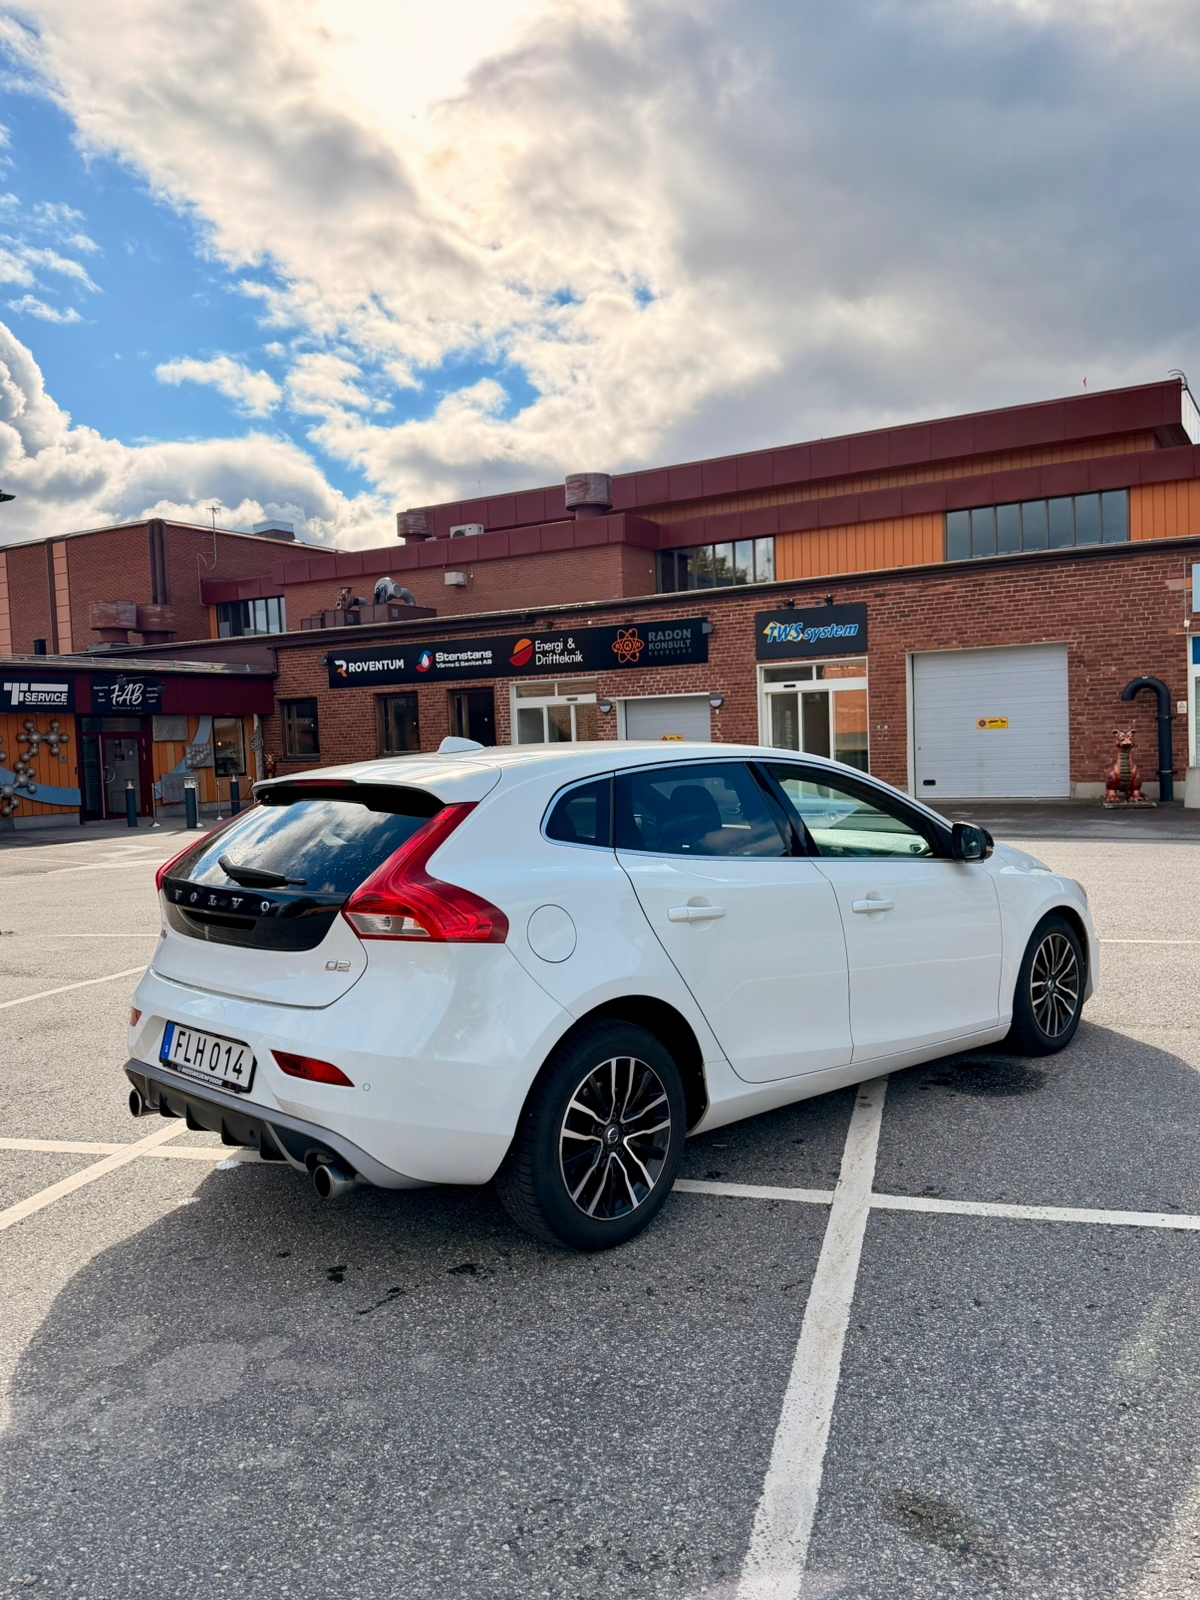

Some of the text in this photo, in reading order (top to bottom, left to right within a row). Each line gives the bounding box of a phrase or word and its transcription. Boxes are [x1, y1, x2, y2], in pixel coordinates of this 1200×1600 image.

[648, 629, 692, 641] RADON
[535, 638, 576, 652] Energi &
[648, 640, 692, 650] KONSULT
[435, 650, 492, 662] Stenstans
[535, 650, 583, 666] Driftteknik
[648, 648, 692, 656] NORRLAND
[348, 659, 404, 673] ROVENTUM
[25, 692, 68, 702] SERVICE
[110, 683, 144, 705] FAB
[174, 889, 270, 912] VOLVO
[325, 959, 351, 972] D2
